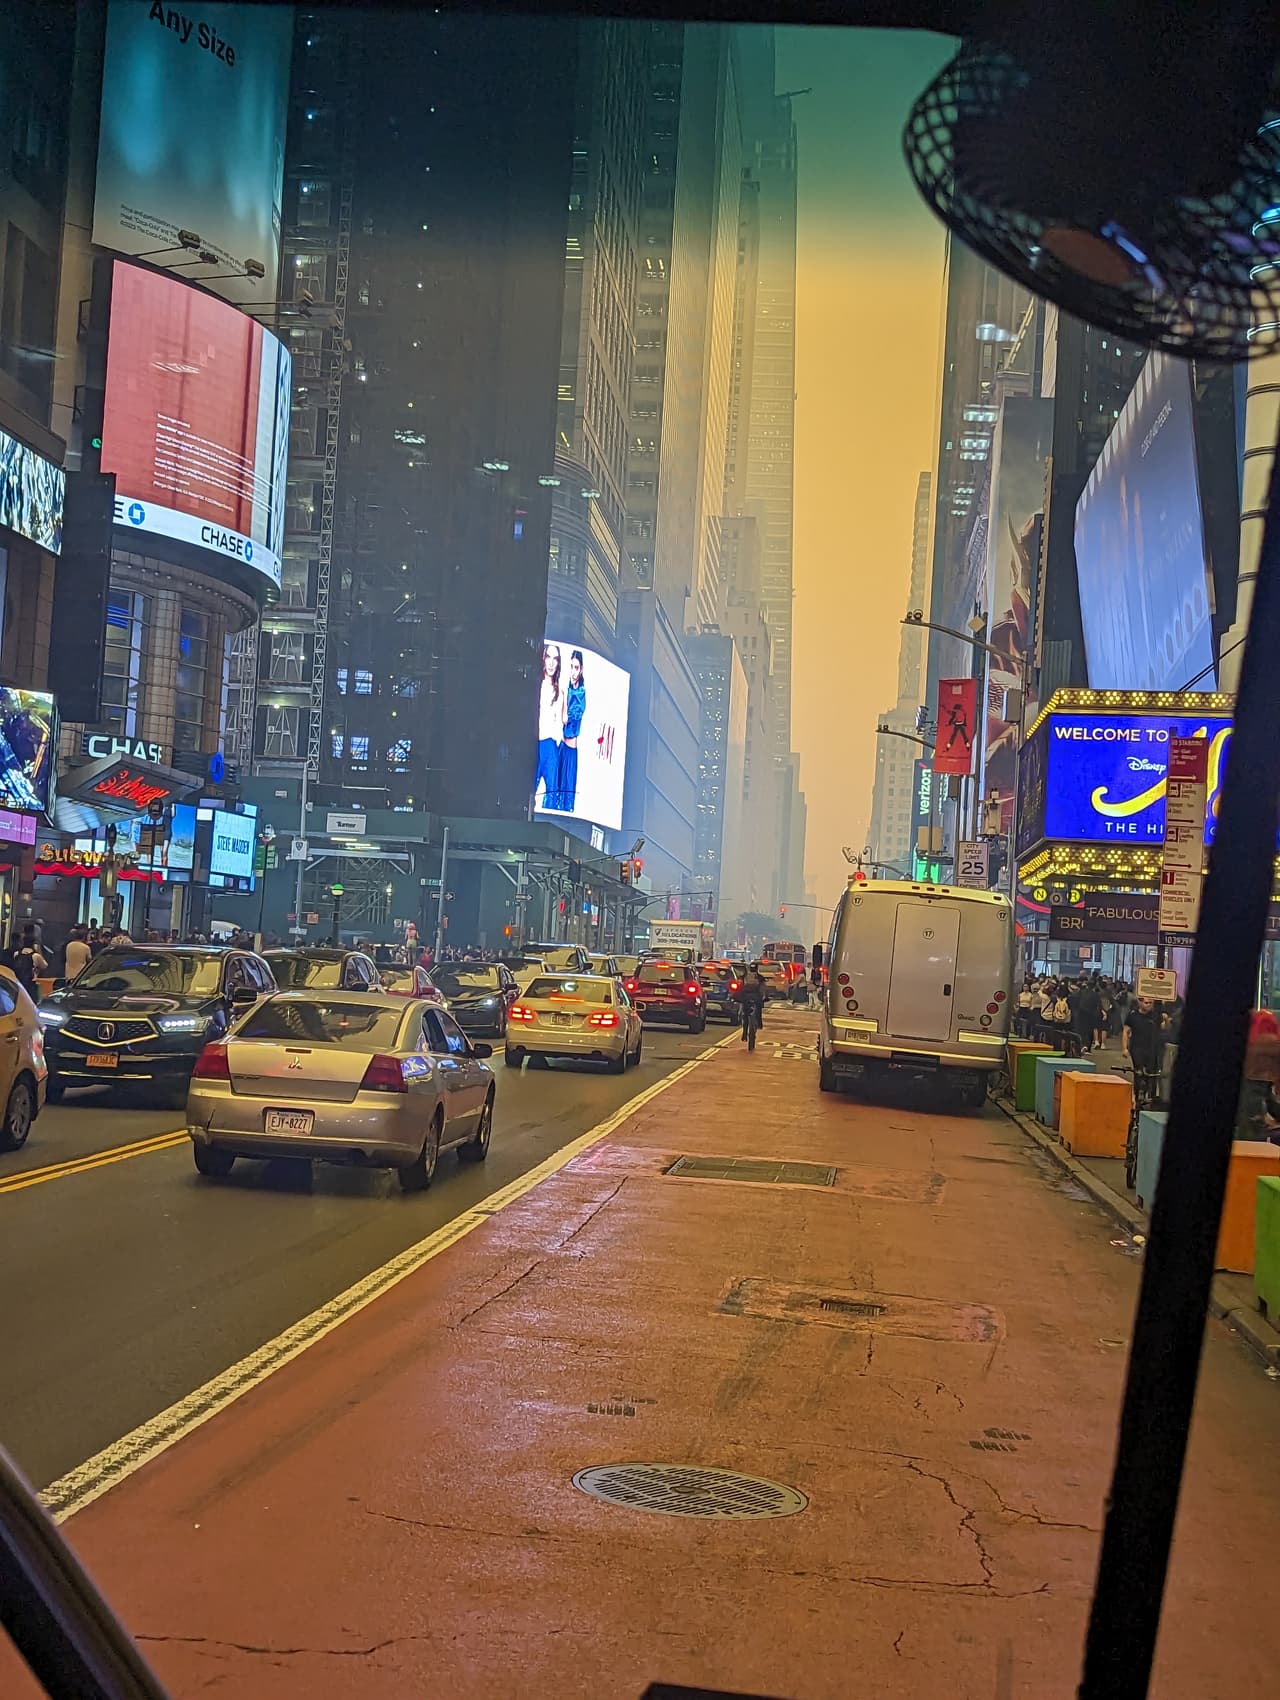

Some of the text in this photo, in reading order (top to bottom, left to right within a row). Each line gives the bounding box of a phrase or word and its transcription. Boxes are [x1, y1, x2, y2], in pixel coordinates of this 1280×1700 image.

[149, 0, 235, 67] Any Size
[201, 525, 243, 556] CHASE
[1055, 726, 1169, 742] WELCOME TO
[1126, 756, 1167, 776] Disney
[919, 768, 932, 815] verizon
[1105, 822, 1137, 834] THE
[961, 861, 984, 875] 25
[1036, 891, 1044, 899] N
